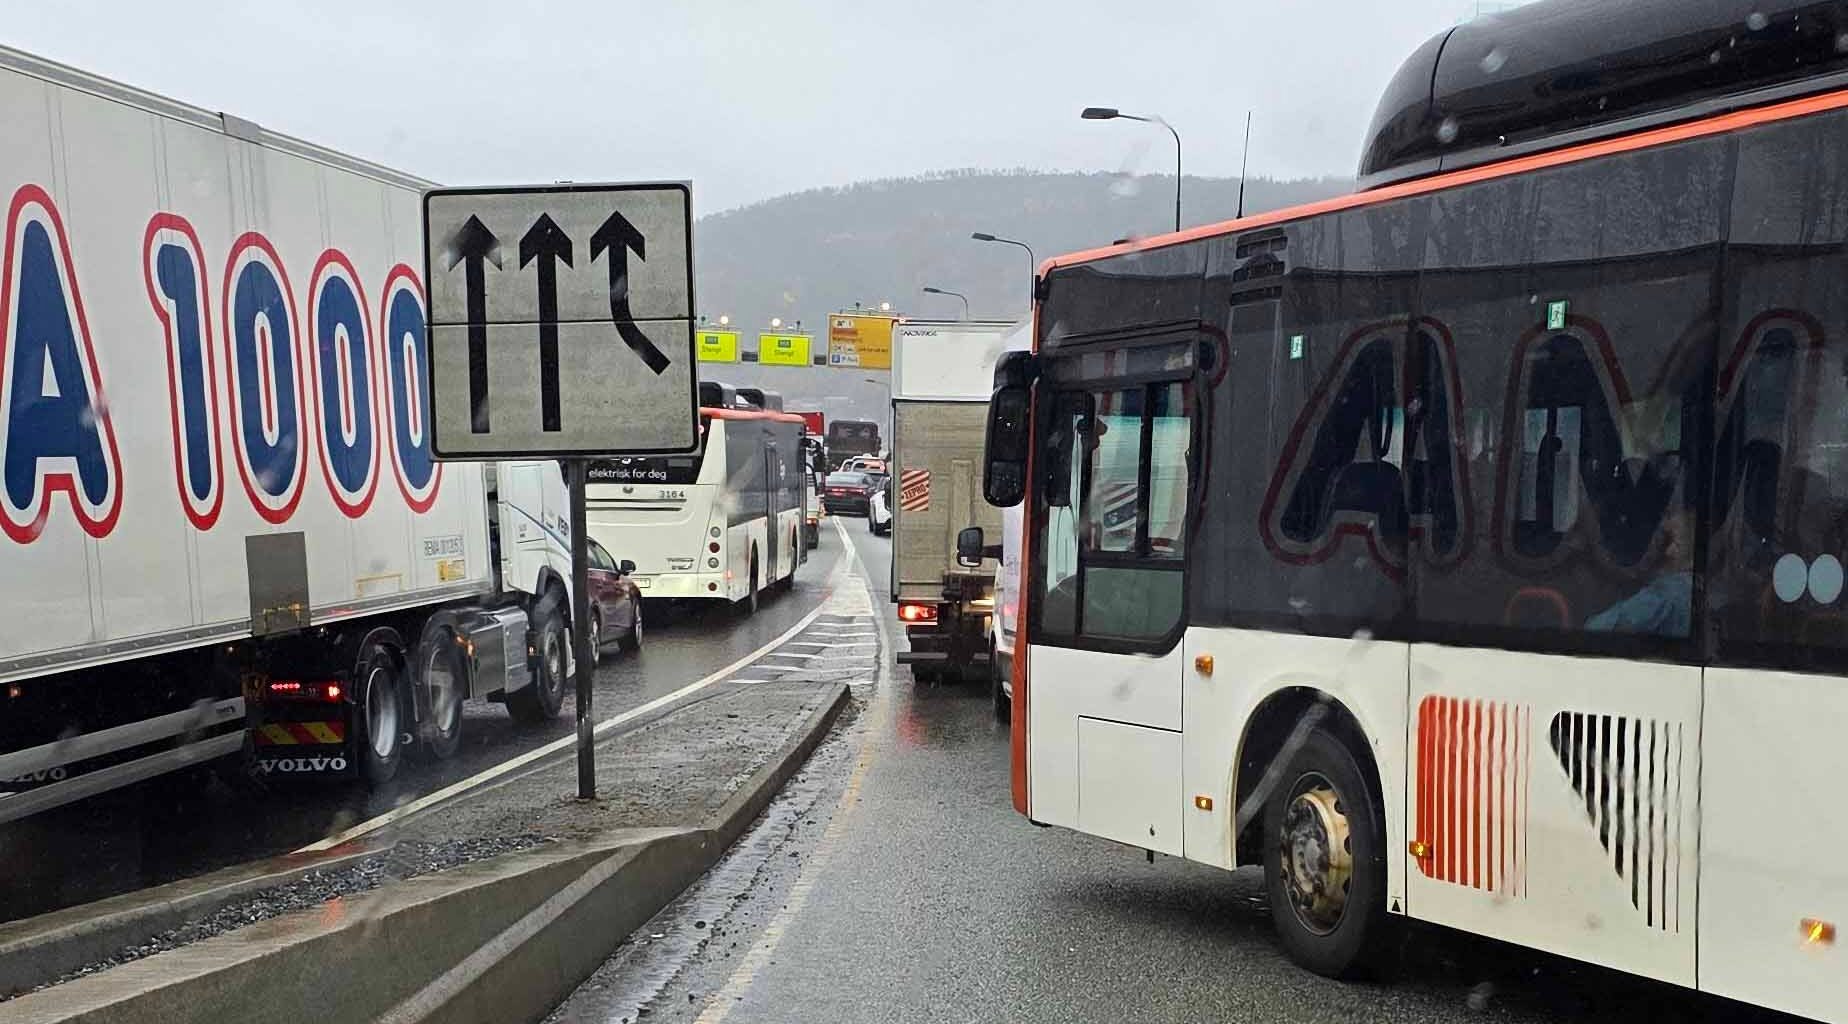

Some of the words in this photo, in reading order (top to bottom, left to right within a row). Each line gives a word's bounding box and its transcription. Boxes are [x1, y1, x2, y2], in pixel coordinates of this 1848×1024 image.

[143, 211, 442, 531] 1000
[588, 468, 631, 478] elektrisk
[632, 468, 646, 478] for
[647, 469, 667, 481] deg
[258, 757, 347, 773] VOLVO
